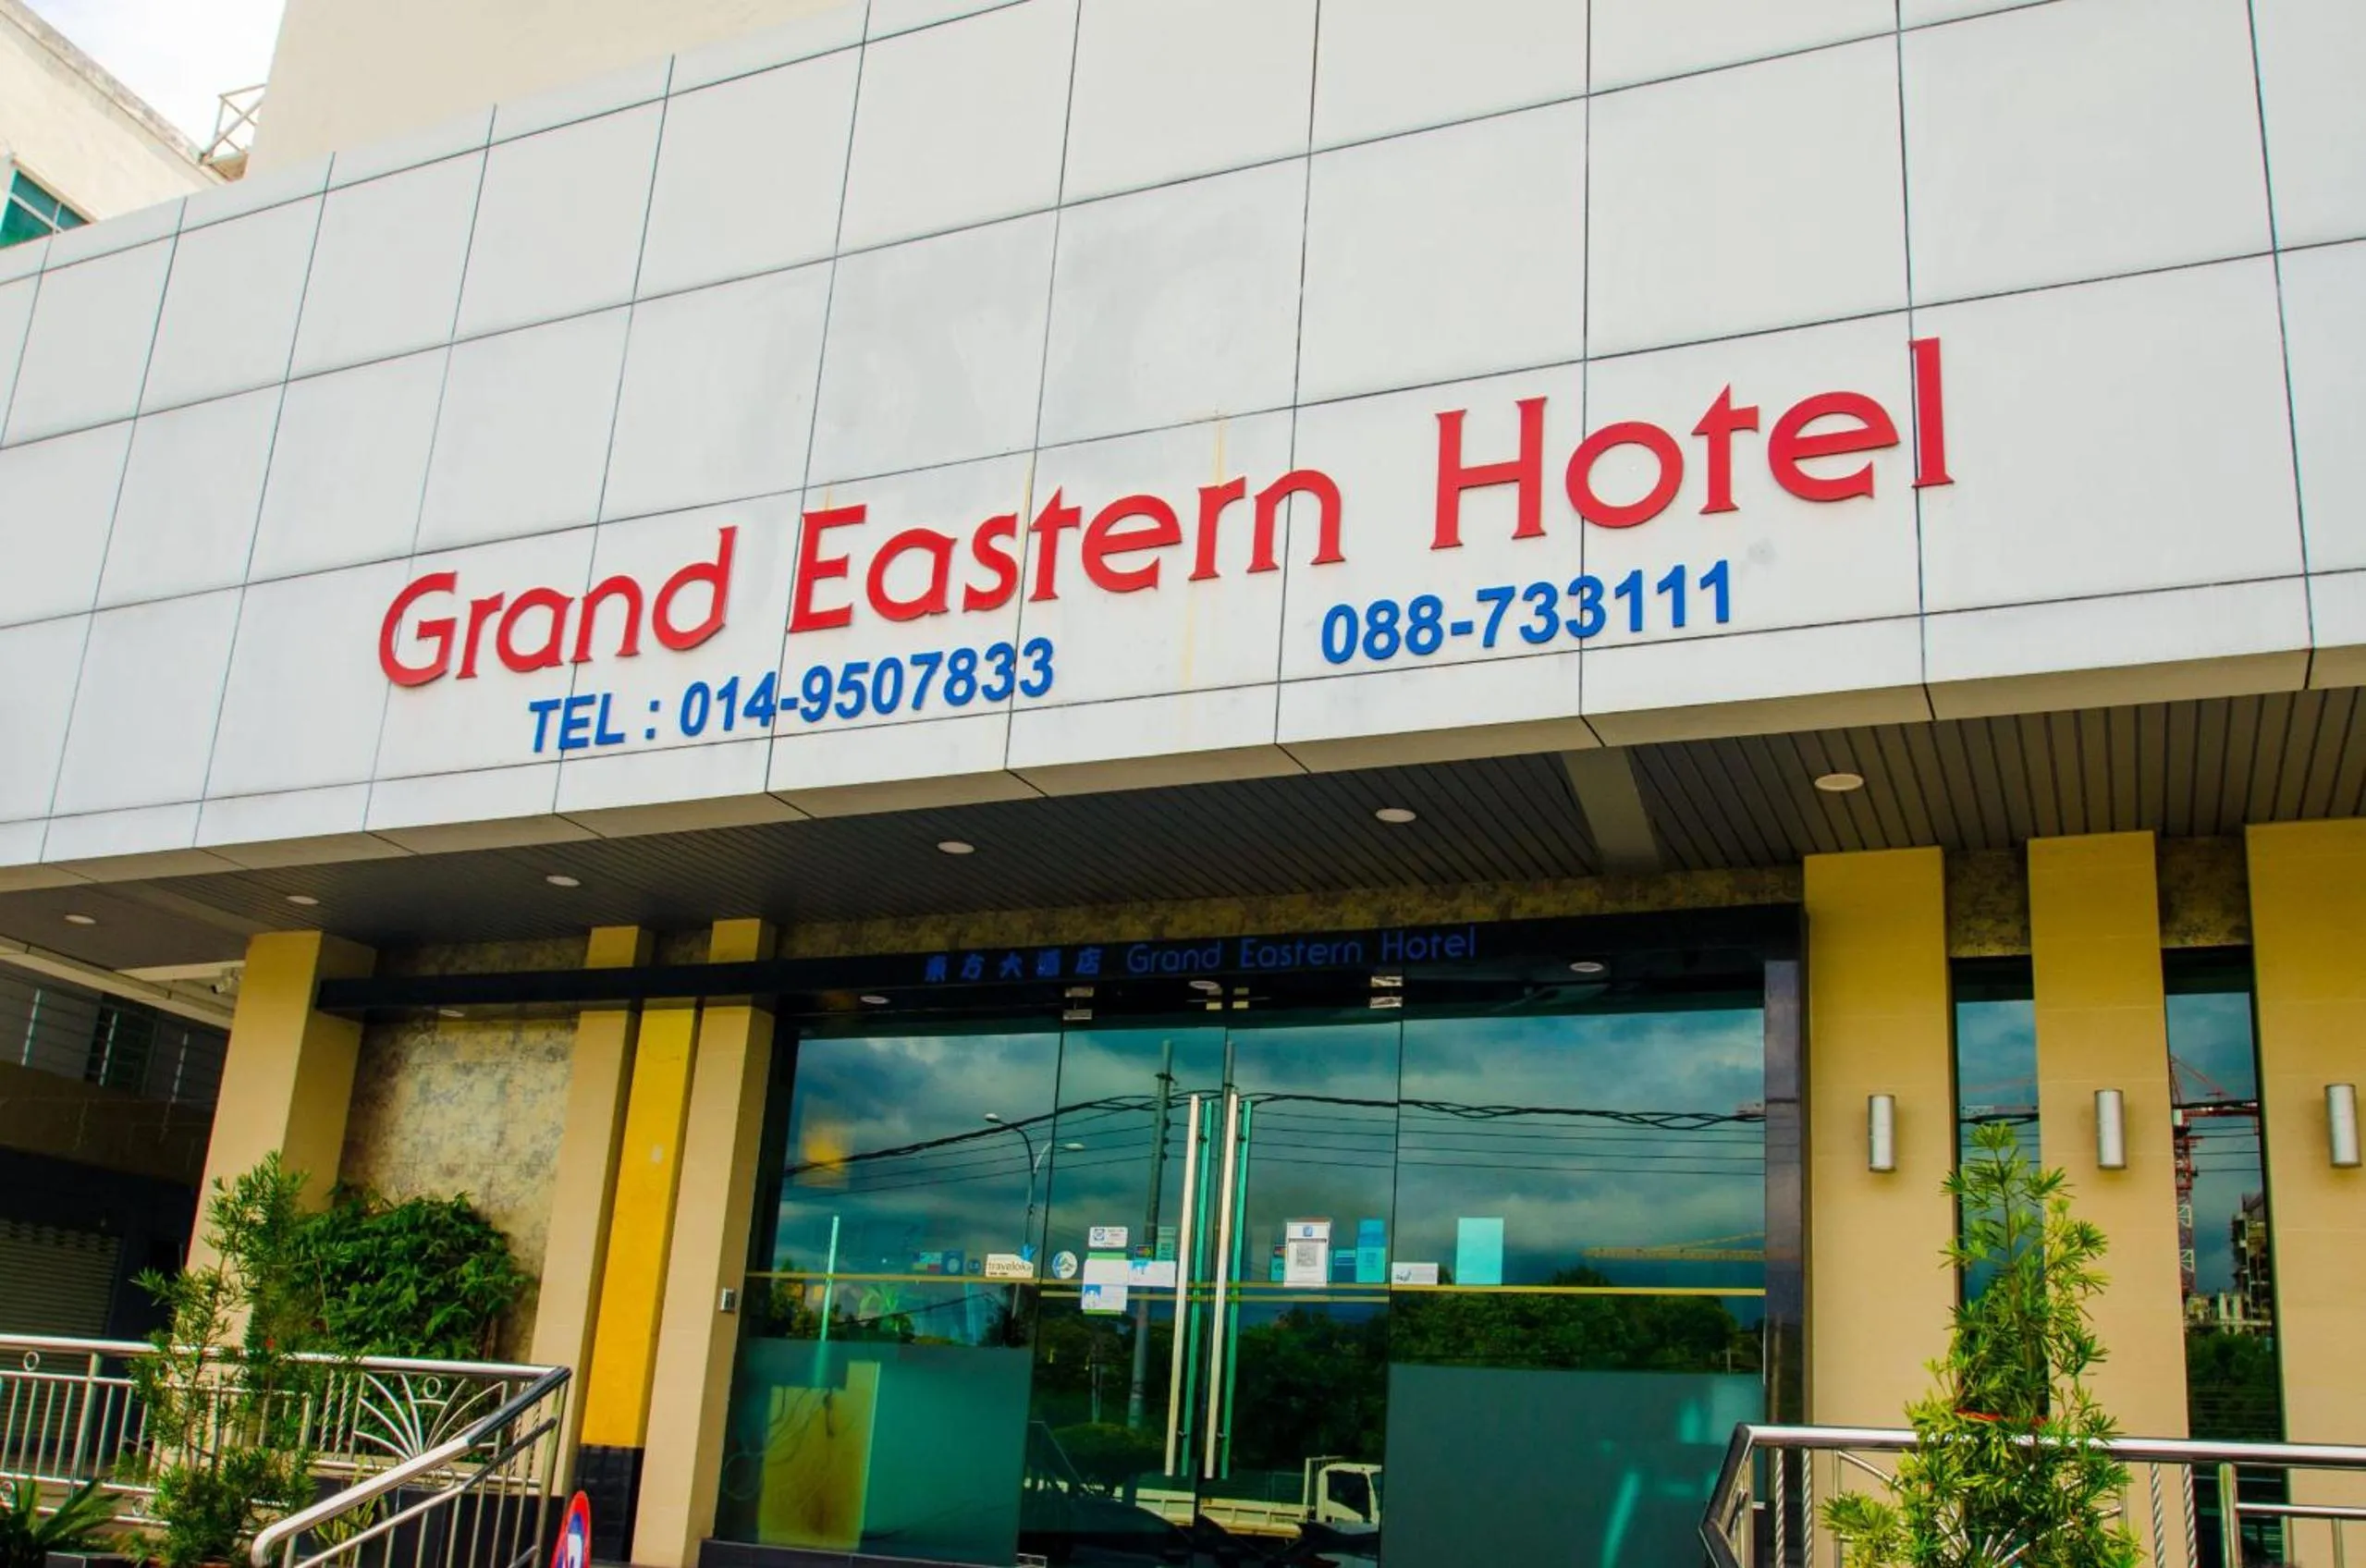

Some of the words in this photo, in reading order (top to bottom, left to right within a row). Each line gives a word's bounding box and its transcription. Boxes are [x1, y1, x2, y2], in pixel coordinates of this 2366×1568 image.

[378, 526, 738, 687] Grand
[788, 469, 1345, 633] Eastern
[1430, 337, 1953, 550] Hotel
[1320, 558, 1732, 665] 088-733111
[528, 692, 626, 753] TEL
[679, 636, 1055, 736] 014-9507833
[1125, 941, 1225, 975] Grand
[1239, 936, 1364, 968] Eastern
[1381, 925, 1477, 960] Hotel
